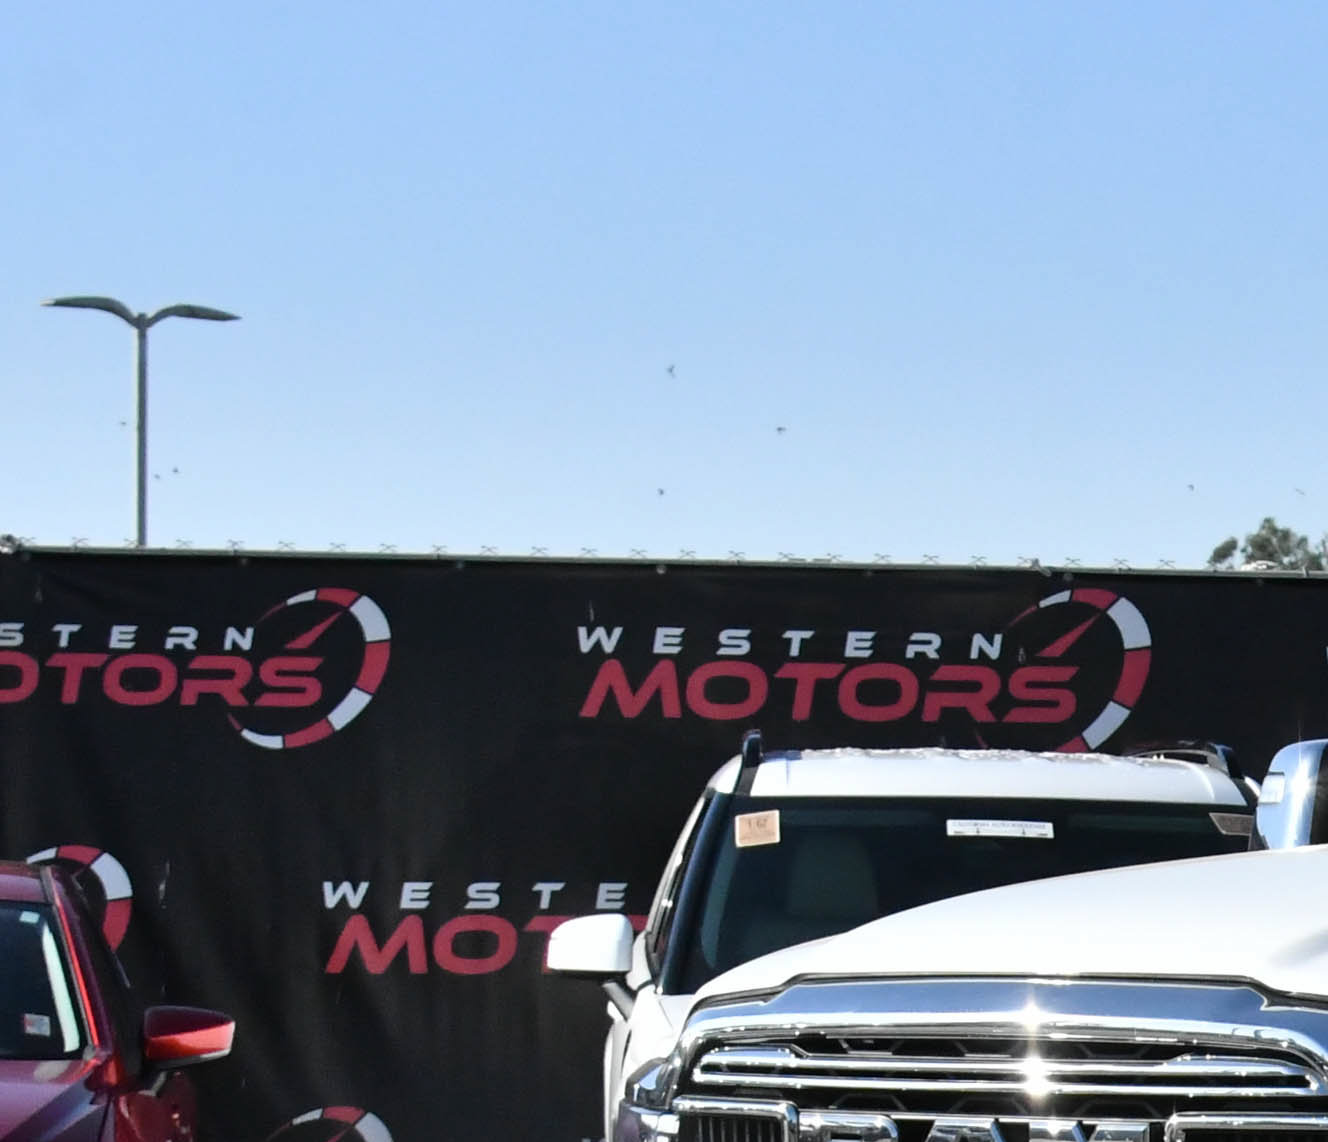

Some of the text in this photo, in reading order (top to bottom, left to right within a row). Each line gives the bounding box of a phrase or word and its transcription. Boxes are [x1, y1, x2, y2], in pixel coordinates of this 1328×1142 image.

[0, 622, 254, 650] STERN
[576, 626, 1003, 661] WESTERN
[578, 658, 1080, 724] MOTORS
[322, 881, 628, 910] WESTE
